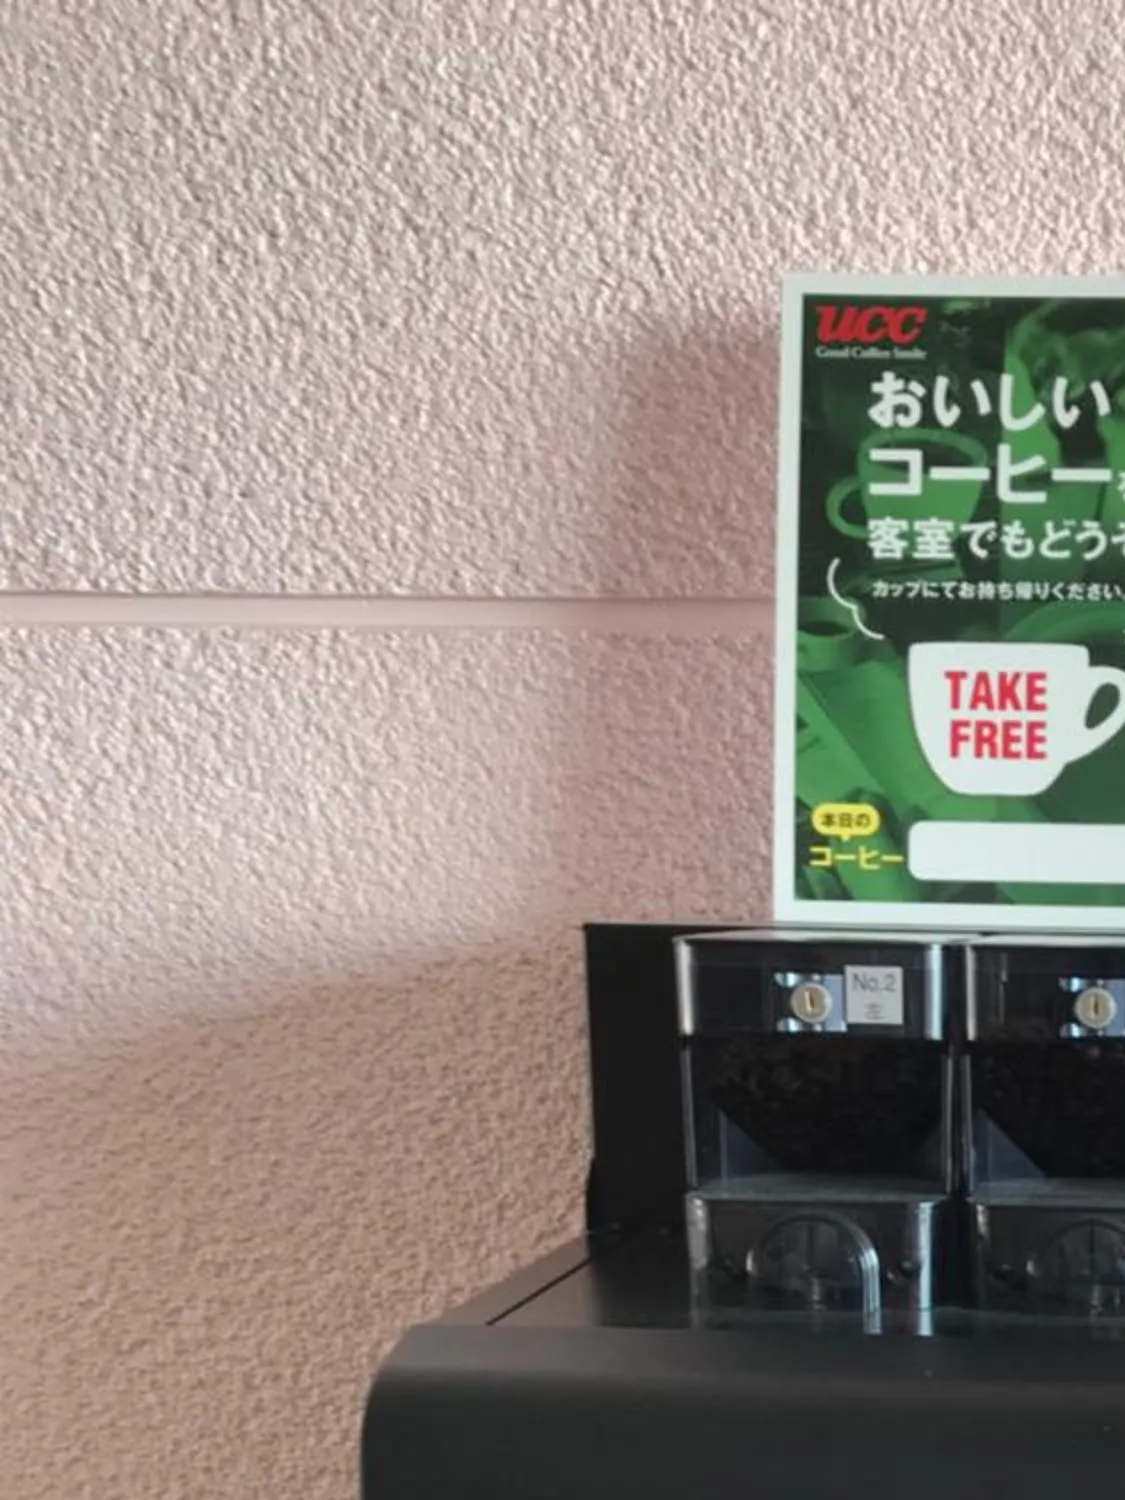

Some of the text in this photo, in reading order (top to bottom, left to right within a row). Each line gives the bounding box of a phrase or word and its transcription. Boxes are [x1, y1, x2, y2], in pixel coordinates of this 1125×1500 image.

[868, 370, 1111, 431] おいしい
[945, 671, 1048, 712] TAKE
[949, 719, 1048, 760] FREE
[820, 812, 872, 829] 本日の
[808, 845, 904, 870] コーヒー
[852, 973, 896, 993] No.2
